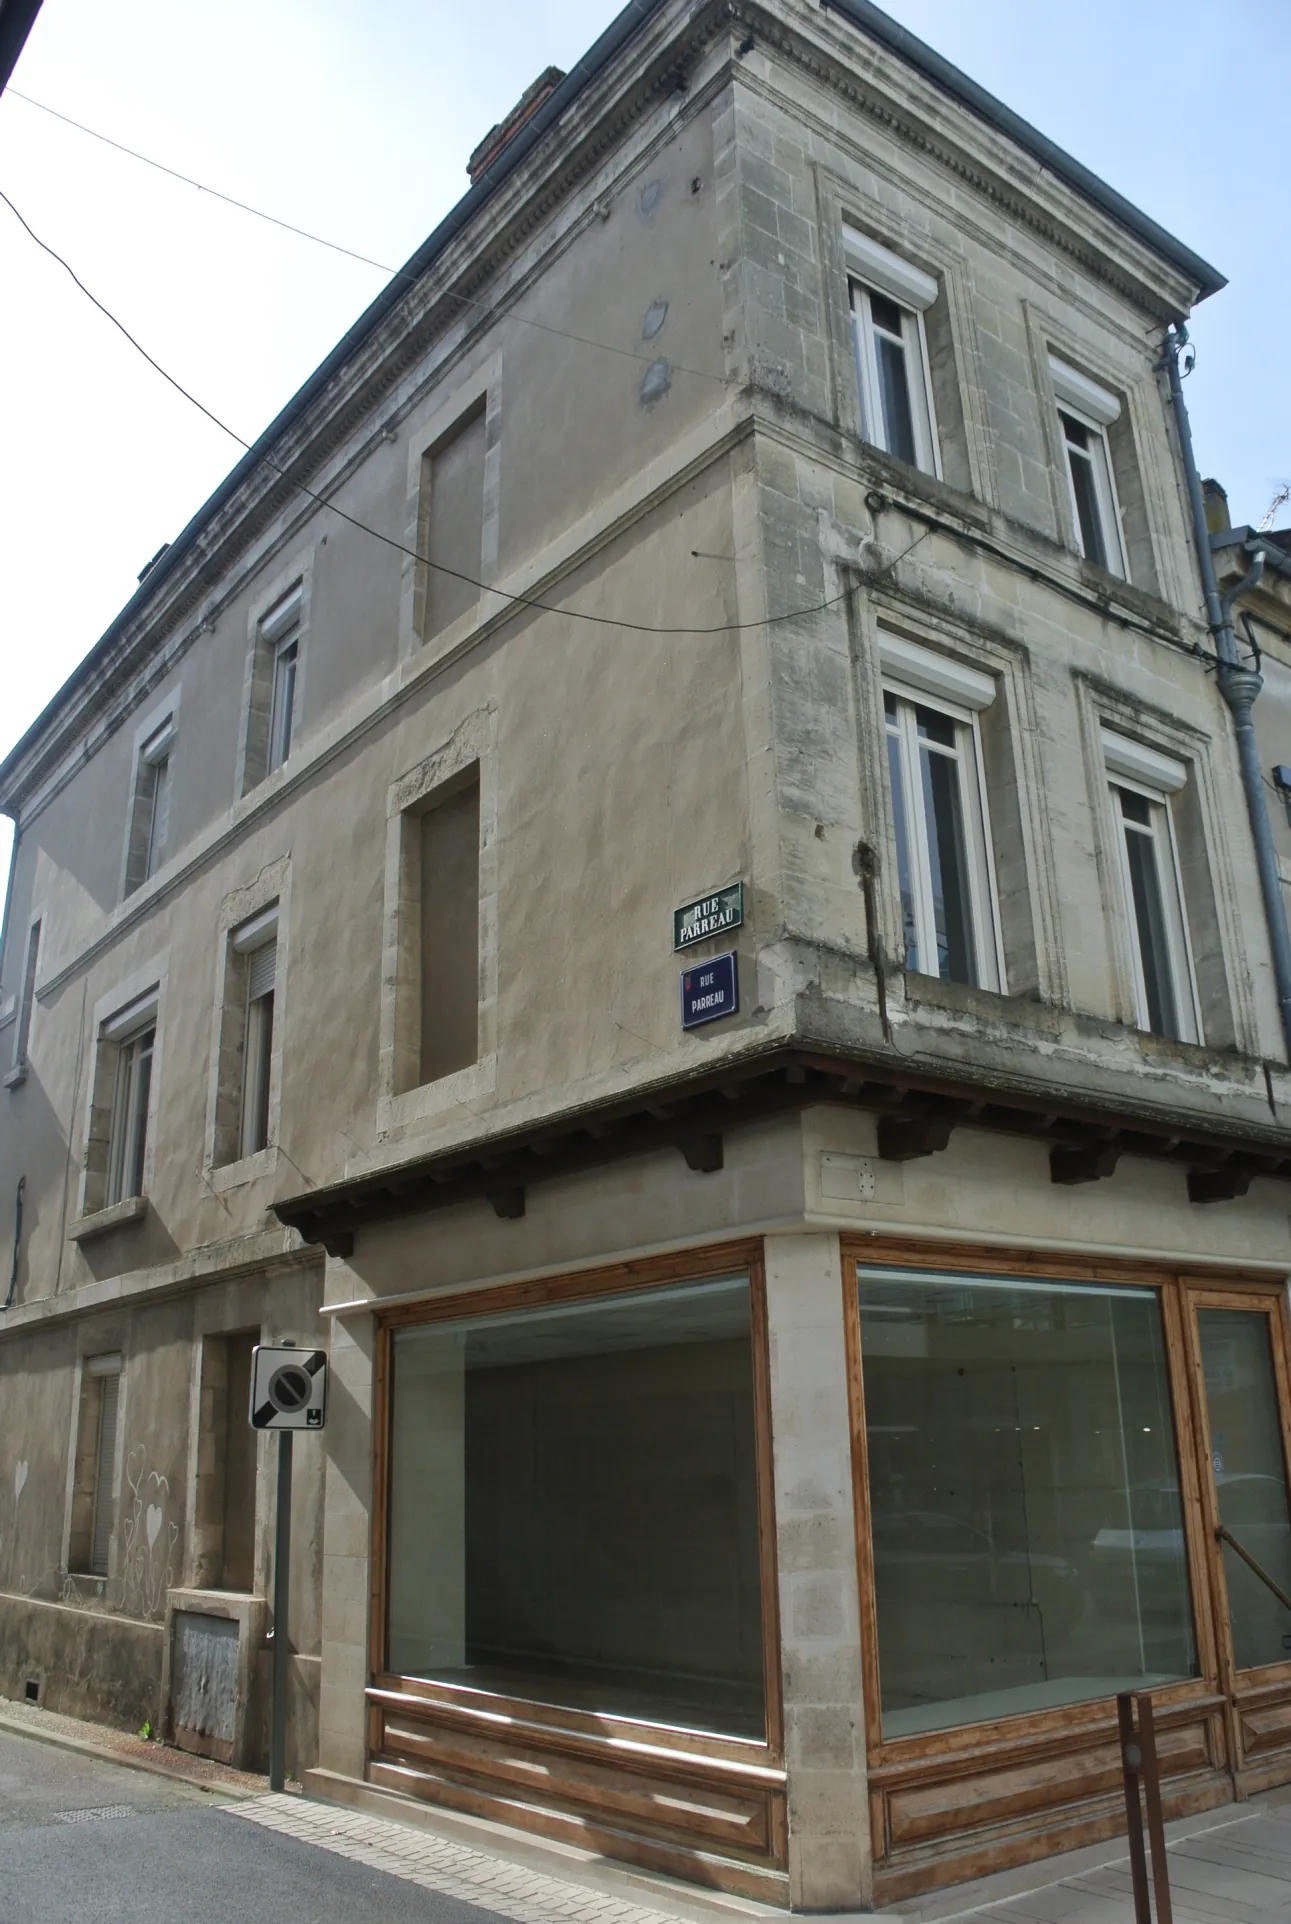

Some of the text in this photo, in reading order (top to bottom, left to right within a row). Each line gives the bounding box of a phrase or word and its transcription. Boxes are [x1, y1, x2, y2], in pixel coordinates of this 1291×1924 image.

[694, 897, 719, 920] RUE
[680, 908, 733, 943] PARREAU
[700, 972, 714, 988] RUE
[691, 990, 724, 1013] PARREAU
